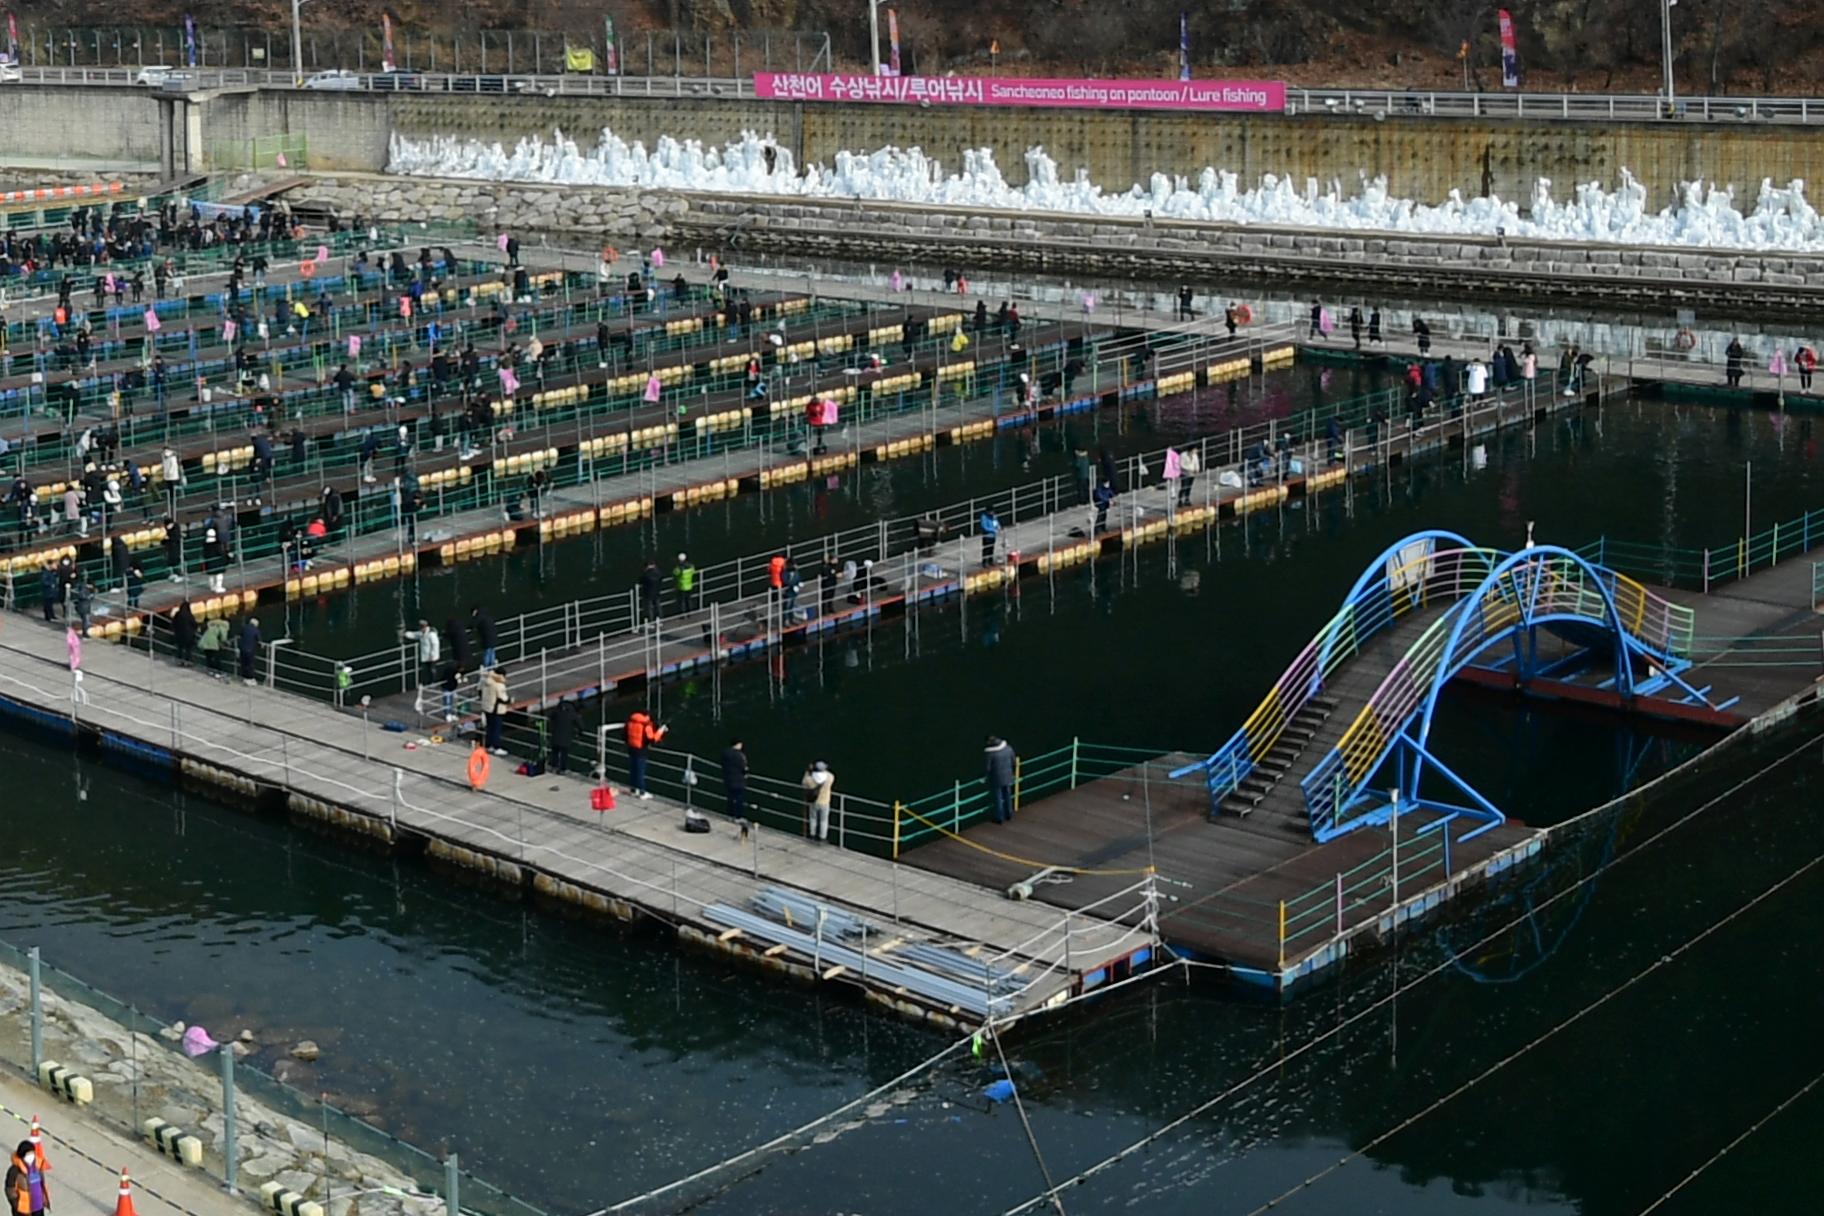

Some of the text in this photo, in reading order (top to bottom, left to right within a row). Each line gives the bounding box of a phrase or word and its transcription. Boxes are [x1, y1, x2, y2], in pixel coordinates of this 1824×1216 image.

[772, 75, 823, 98] 산천어
[1067, 85, 1107, 103] fishing
[1110, 88, 1125, 101] on
[1128, 88, 1179, 105] pontoon
[1190, 87, 1220, 102] Lure
[1222, 87, 1267, 107] fishing
